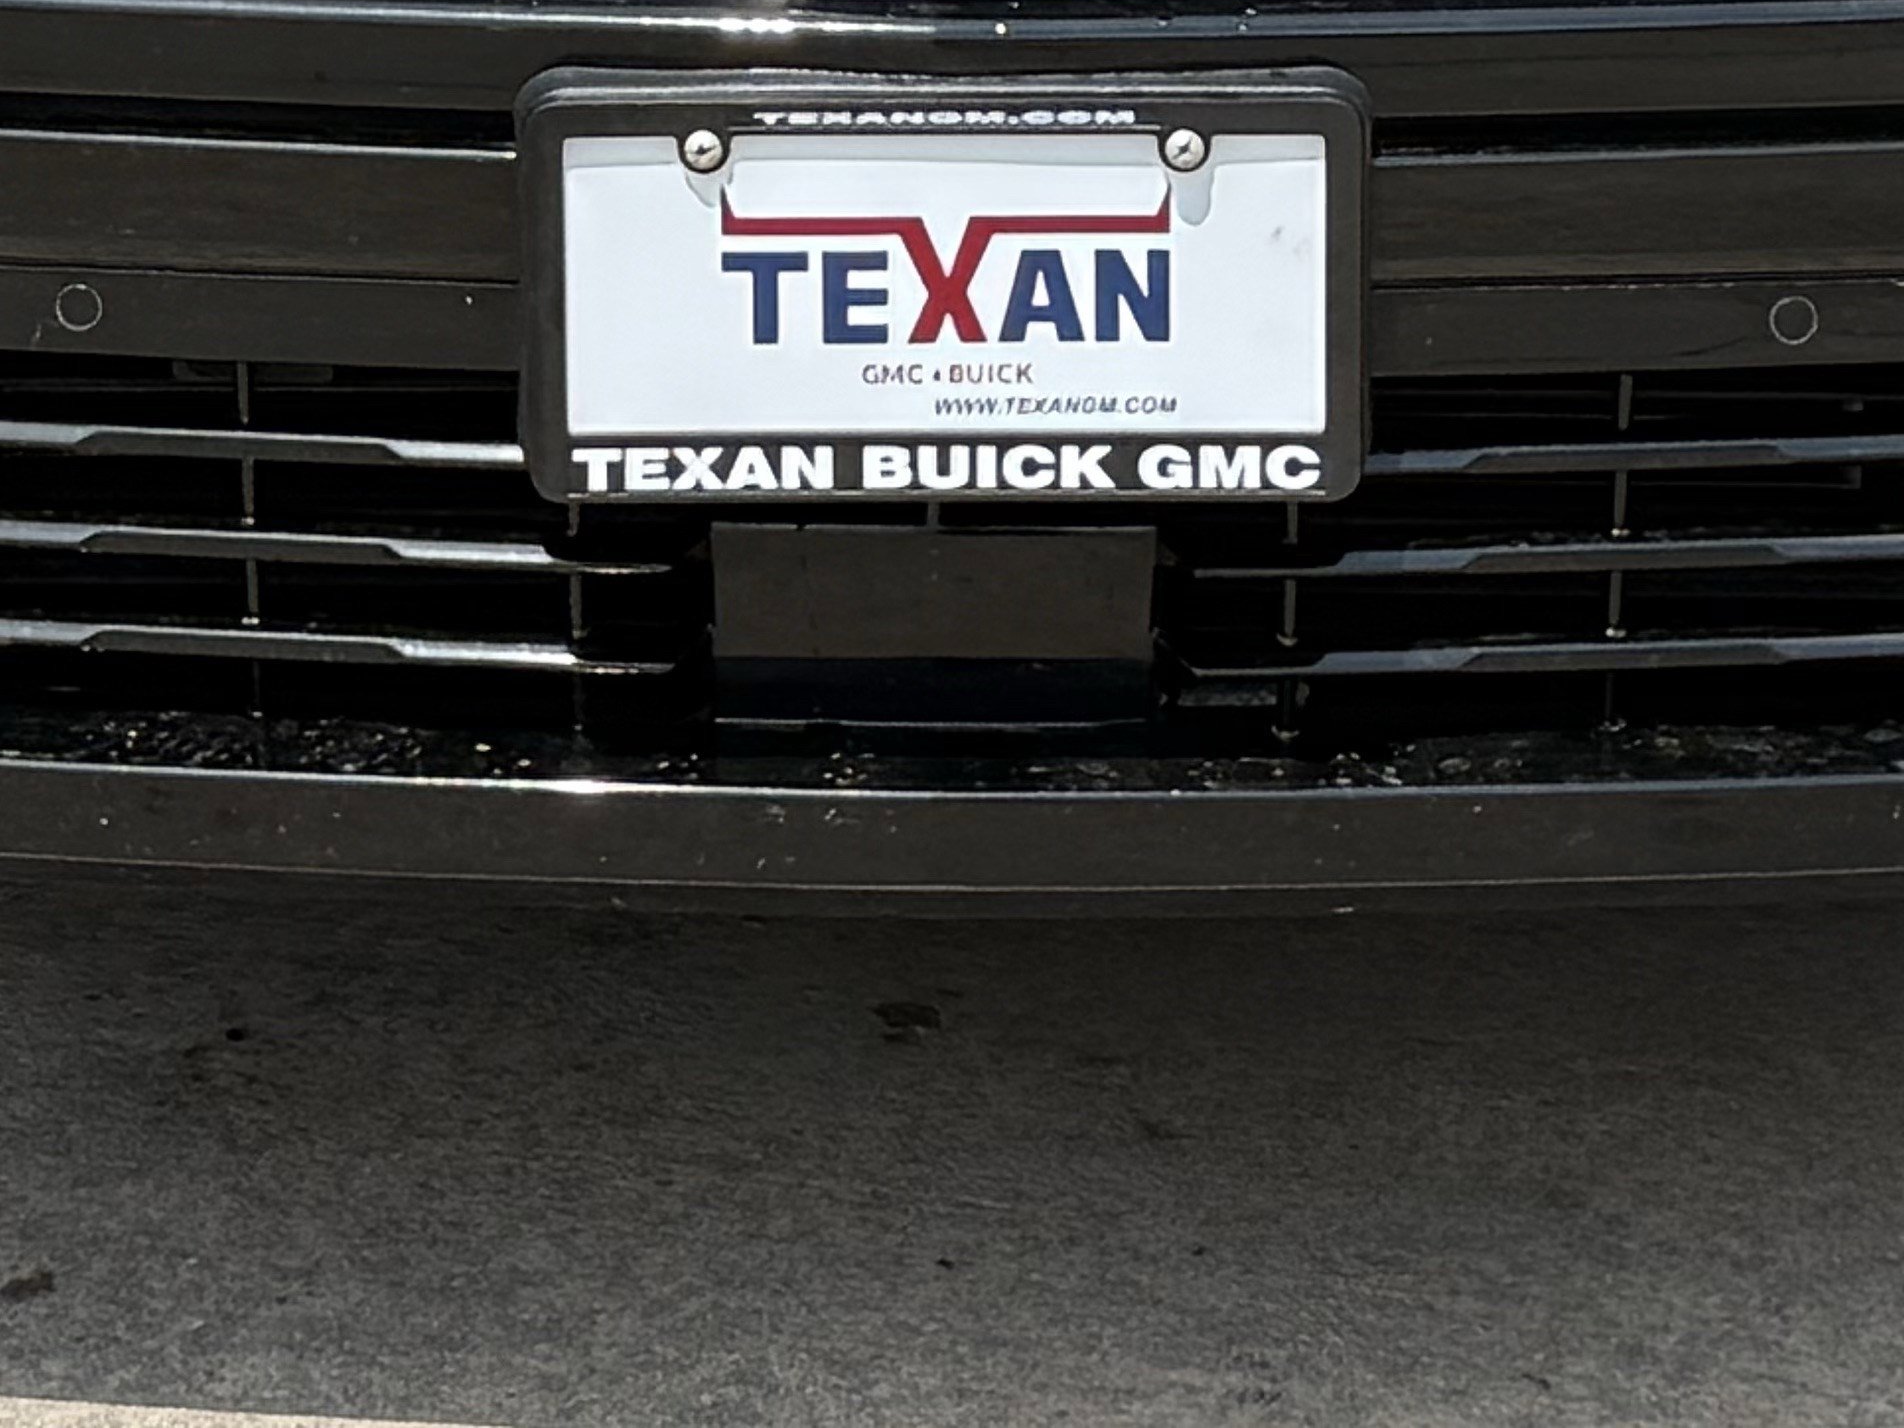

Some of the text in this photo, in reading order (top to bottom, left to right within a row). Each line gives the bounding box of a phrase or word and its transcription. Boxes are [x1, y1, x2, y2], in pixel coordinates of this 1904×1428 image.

[720, 214, 1172, 345] TEXAN
[861, 362, 1034, 385] GMC BUICK
[570, 444, 1322, 492] TEXAN BUICK GMC
